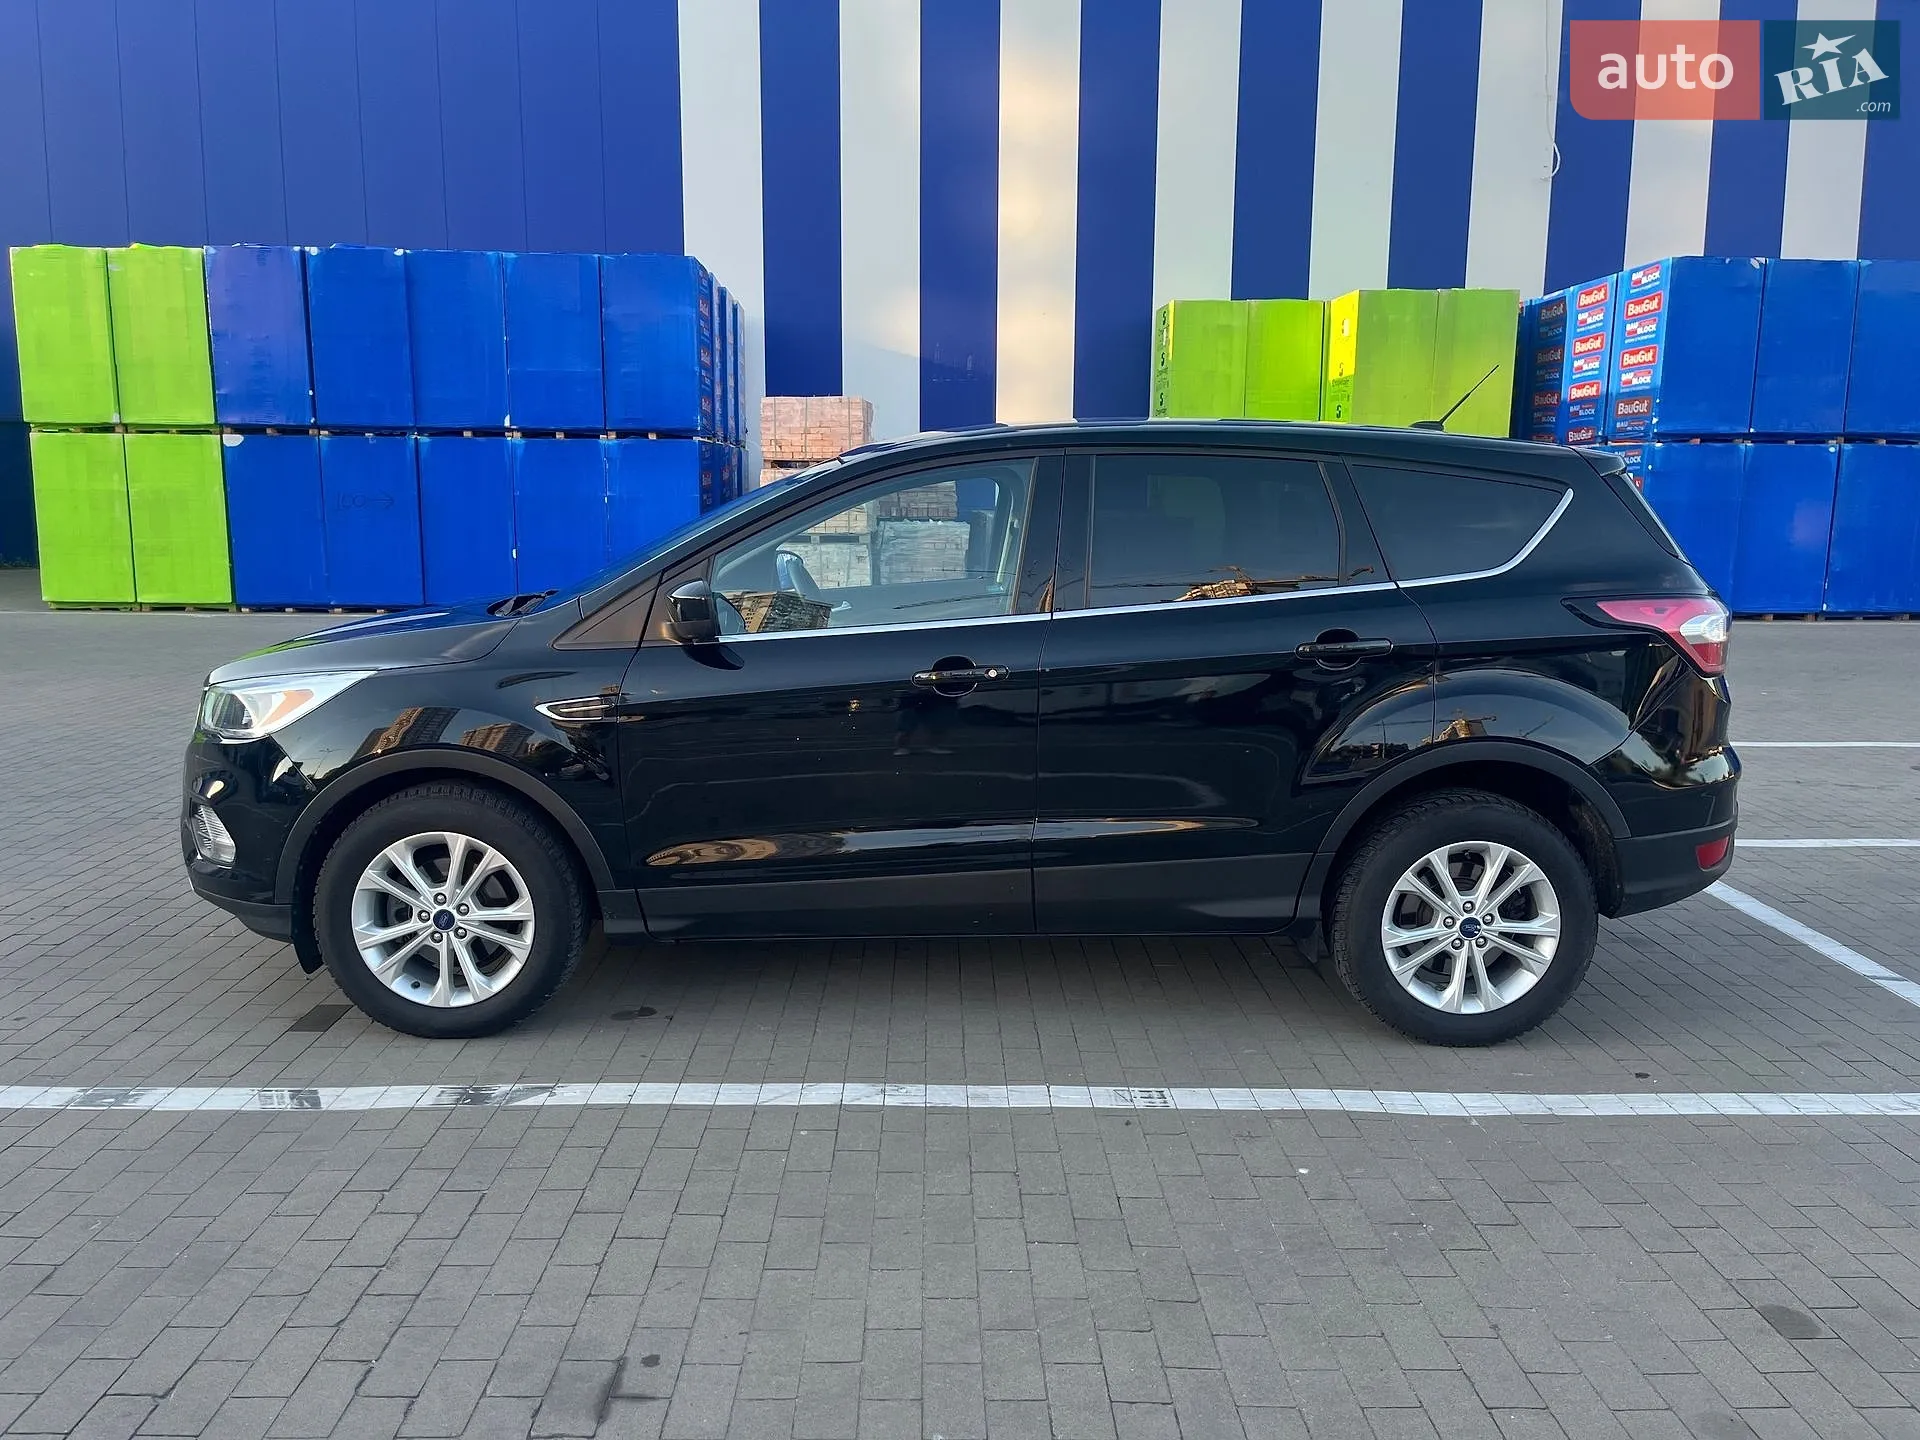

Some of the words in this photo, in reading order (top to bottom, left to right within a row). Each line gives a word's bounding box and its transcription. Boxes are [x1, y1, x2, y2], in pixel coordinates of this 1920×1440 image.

[1641, 271, 1660, 284] BLOCK
[1580, 287, 1606, 306] BauGut
[1541, 303, 1564, 320] BauGut
[1627, 296, 1659, 316] BauGut
[1586, 312, 1604, 324] BLOCK
[1637, 323, 1657, 335] BLOCK
[1575, 336, 1602, 353] BauGut
[1623, 350, 1654, 367] BauGut
[1582, 361, 1600, 371] BLOCK
[1631, 376, 1652, 385] BLOCK
[1571, 383, 1597, 399] BauGut
[1534, 393, 1558, 405] BauGut
[1617, 400, 1648, 415] BauGut
[1568, 430, 1593, 442] BauGut
